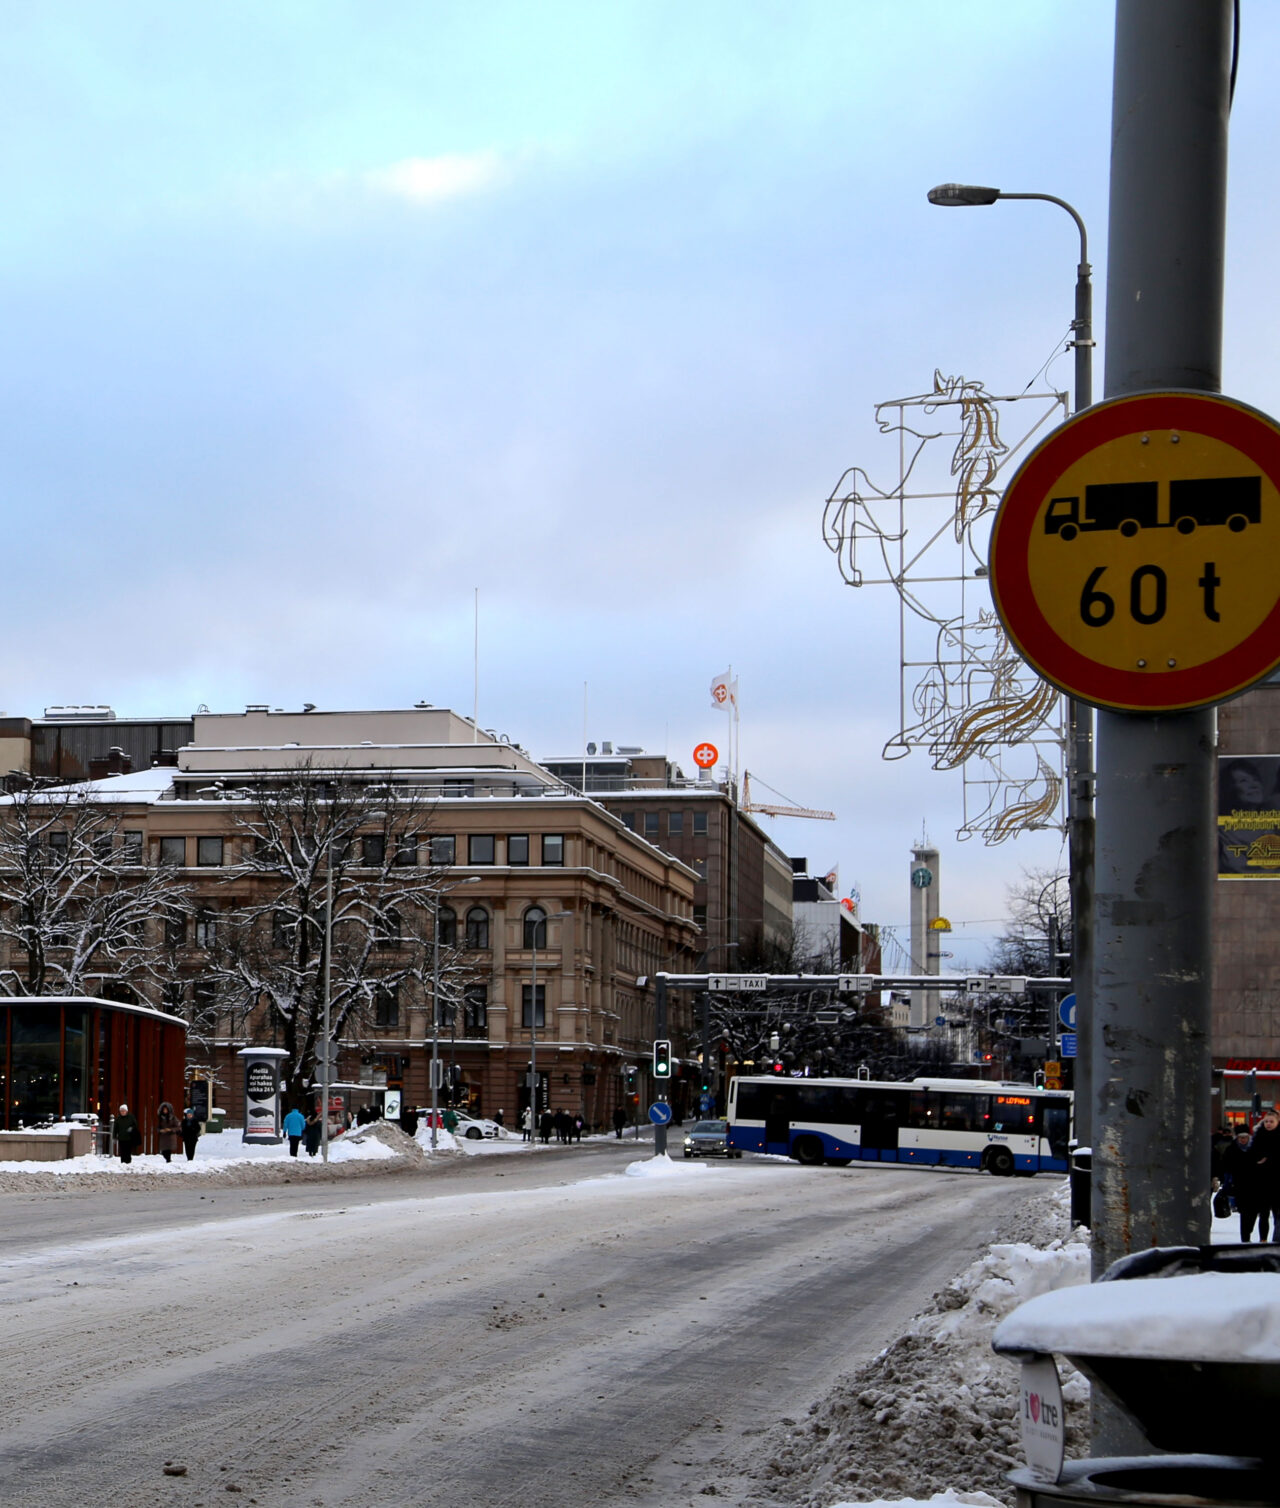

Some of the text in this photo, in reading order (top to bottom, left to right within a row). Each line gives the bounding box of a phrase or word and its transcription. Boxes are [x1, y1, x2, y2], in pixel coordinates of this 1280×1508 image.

[1079, 562, 1221, 628] 60 t
[743, 979, 763, 988] TAXI
